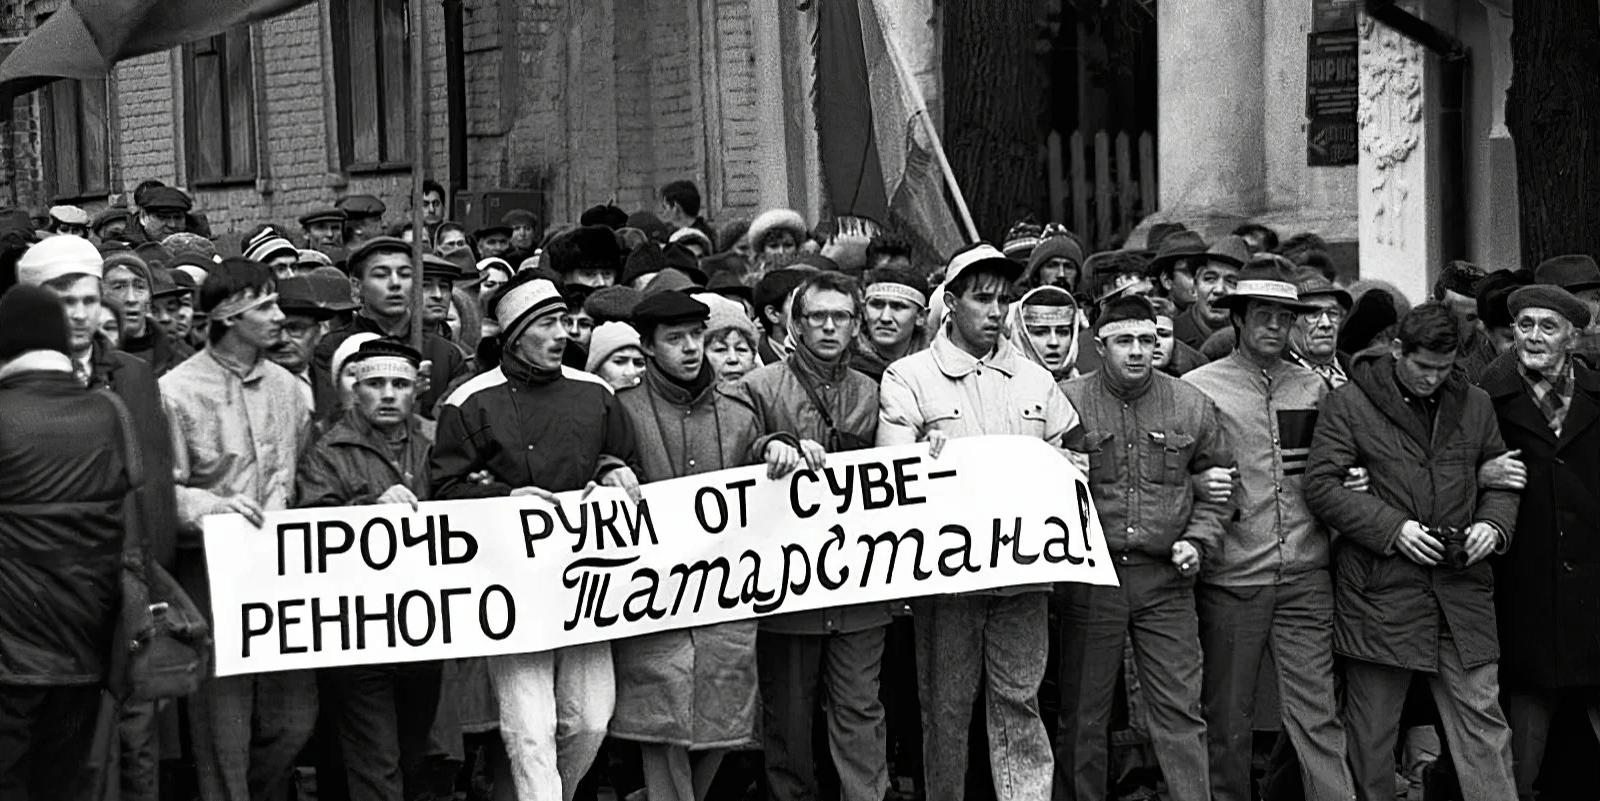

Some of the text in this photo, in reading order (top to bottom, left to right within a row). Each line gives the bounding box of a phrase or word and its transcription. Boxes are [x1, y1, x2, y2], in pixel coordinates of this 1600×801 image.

[241, 479, 1096, 658] РЕННОГО Татарстана!
[276, 456, 957, 576] ПРОЧЬ РУКИ ОТ СУВЕ-
